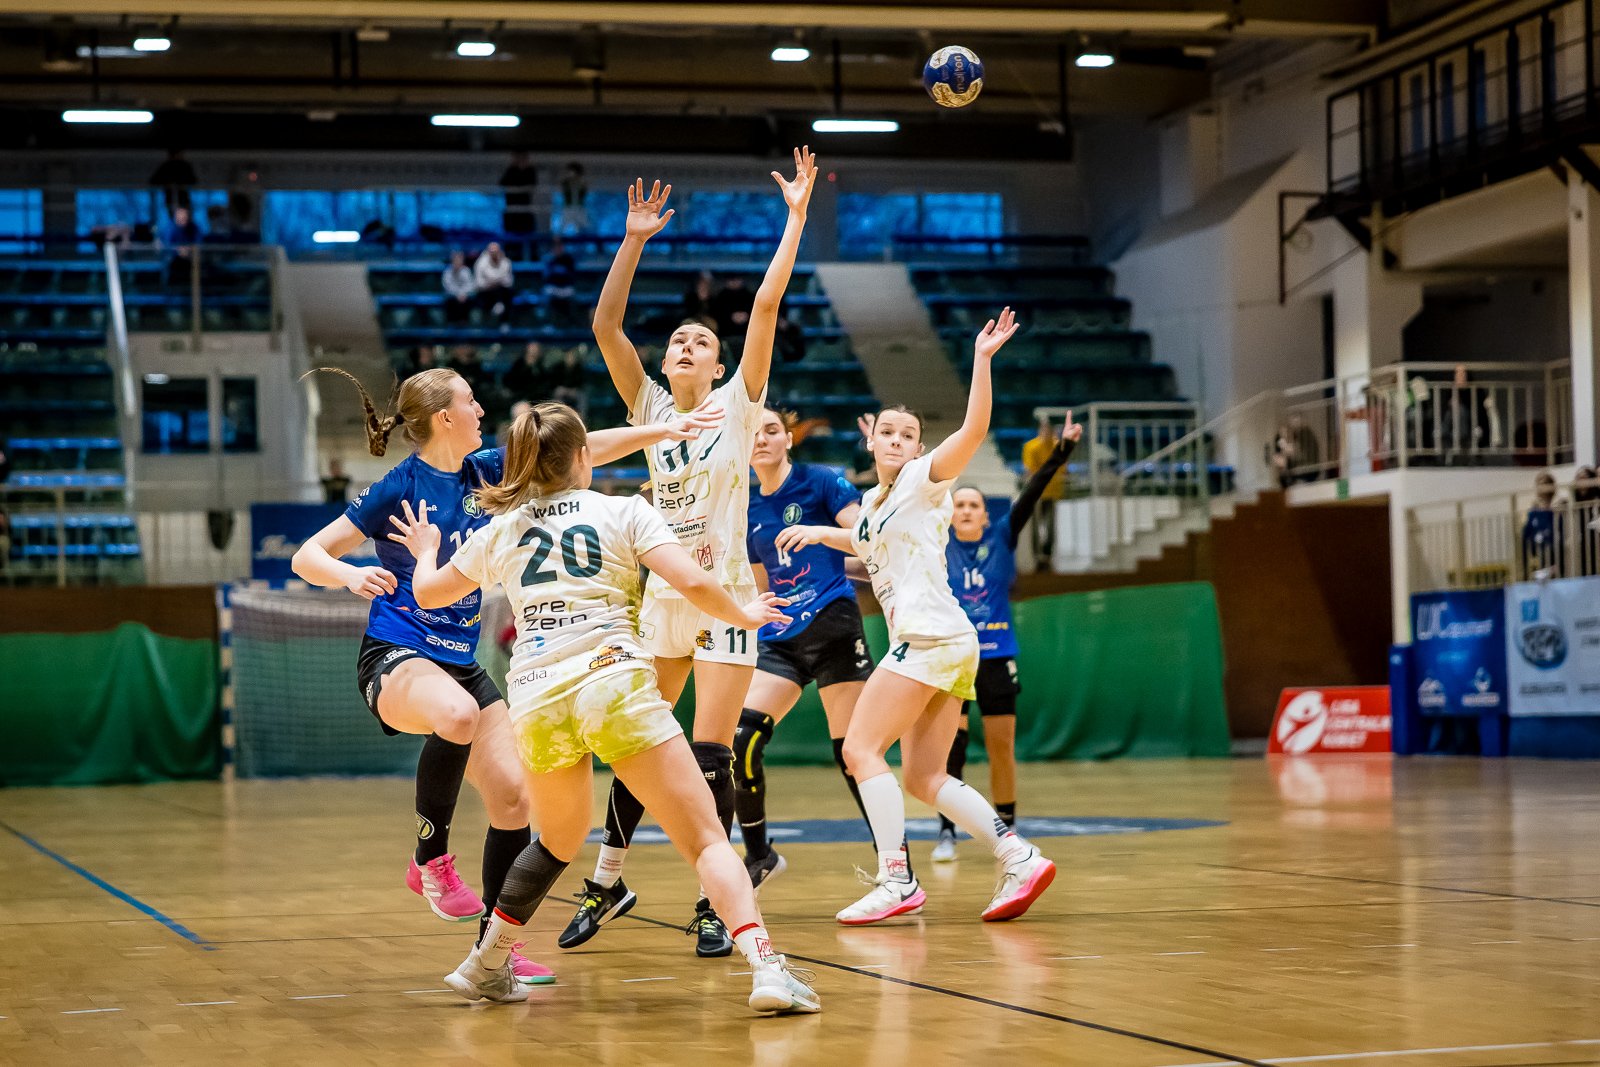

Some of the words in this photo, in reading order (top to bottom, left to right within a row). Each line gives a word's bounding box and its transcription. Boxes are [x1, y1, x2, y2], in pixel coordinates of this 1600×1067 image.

[532, 500, 580, 519] WACH
[517, 524, 603, 588] 20
[725, 626, 747, 654] 11
[892, 641, 910, 662] 4
